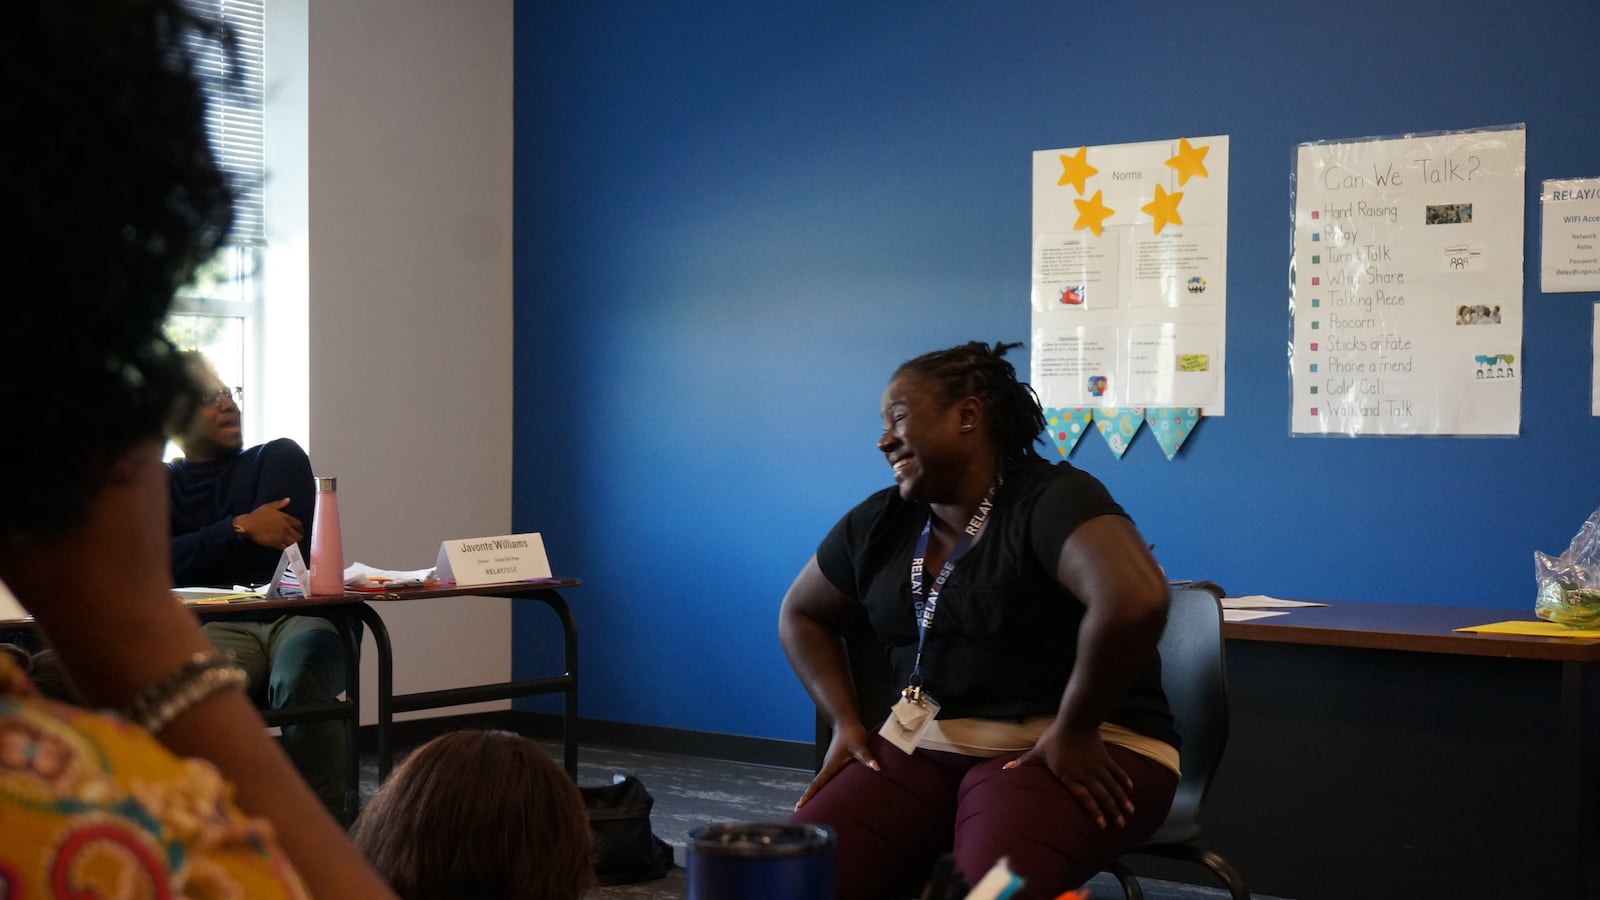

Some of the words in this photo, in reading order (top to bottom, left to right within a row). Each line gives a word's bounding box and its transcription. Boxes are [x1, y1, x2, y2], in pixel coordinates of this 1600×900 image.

[1112, 170, 1143, 181] Norms
[1324, 166, 1364, 191] Can
[1373, 162, 1403, 187] We
[1414, 155, 1480, 184] Talk?
[1324, 202, 1352, 220] Hand
[1357, 200, 1398, 223] Raising
[1325, 246, 1353, 264] Turn
[1363, 244, 1392, 263] Talk
[1365, 266, 1404, 285] Share
[1376, 289, 1405, 306] Piece
[1329, 313, 1375, 334] Popcorn
[1326, 334, 1367, 352] Sticks
[1384, 334, 1412, 351] Fate
[1328, 356, 1365, 374] Phone
[1368, 362, 1377, 373] a
[1359, 379, 1385, 396] Call
[1360, 400, 1380, 417] and
[1385, 400, 1413, 417] Talk
[494, 539, 528, 550] Williams
